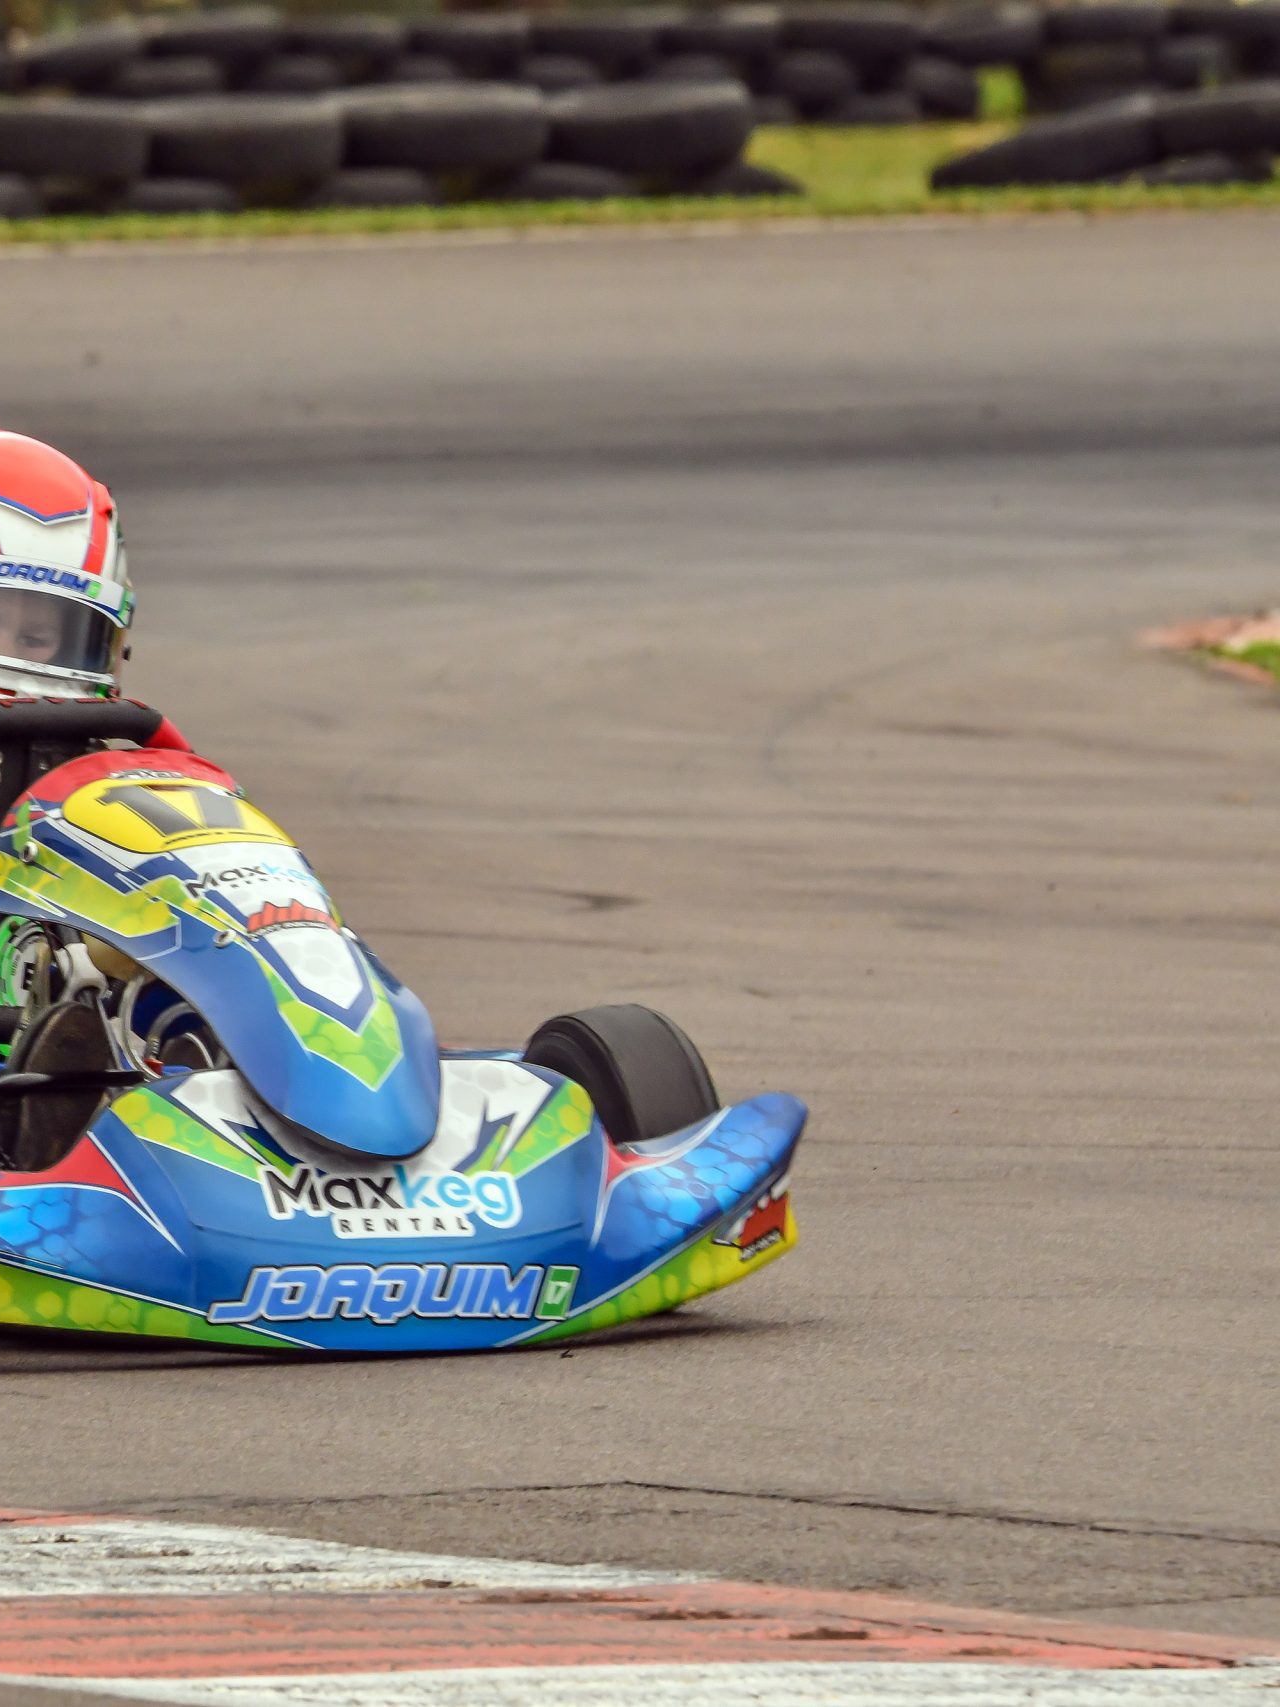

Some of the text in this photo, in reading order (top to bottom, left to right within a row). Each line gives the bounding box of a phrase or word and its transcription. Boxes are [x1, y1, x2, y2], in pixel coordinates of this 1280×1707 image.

[264, 1163, 514, 1222] Maxkeg
[339, 1217, 471, 1234] RENTAL
[208, 1265, 544, 1323] JOAQUIM
